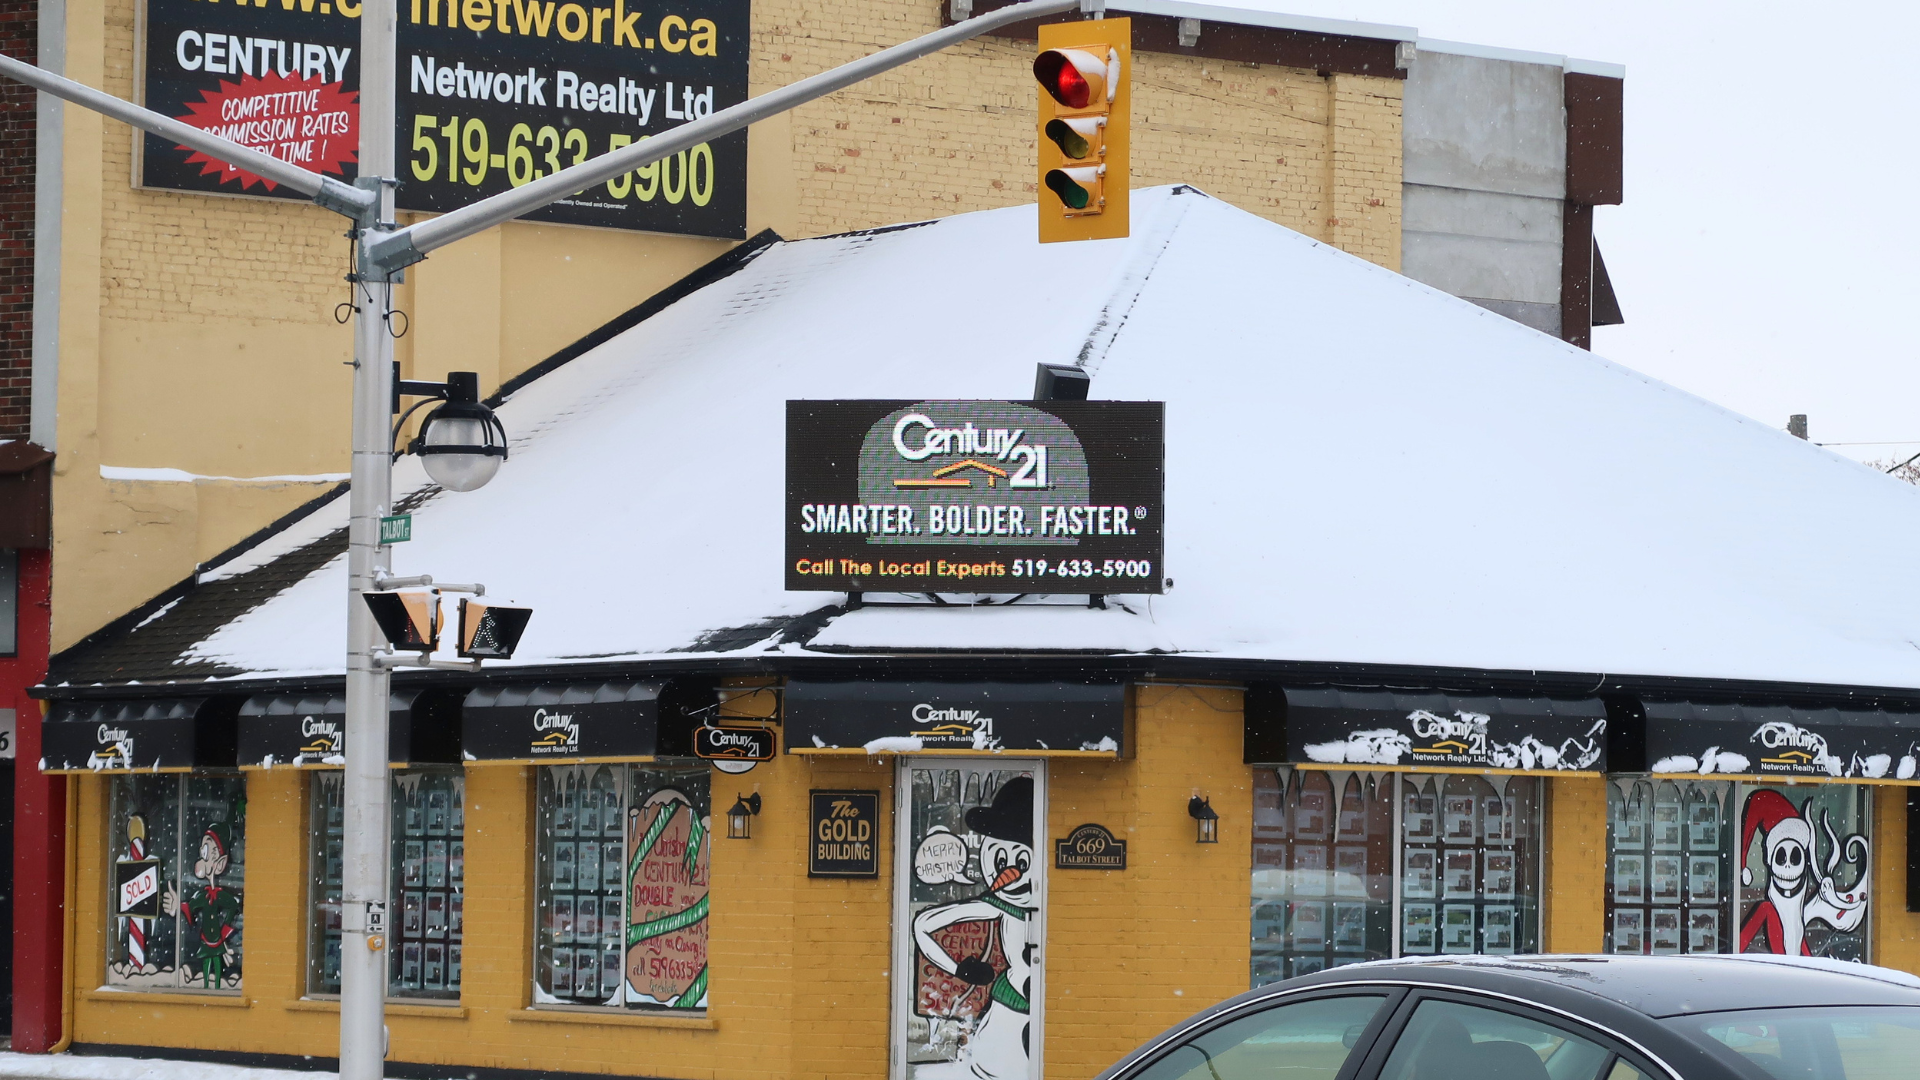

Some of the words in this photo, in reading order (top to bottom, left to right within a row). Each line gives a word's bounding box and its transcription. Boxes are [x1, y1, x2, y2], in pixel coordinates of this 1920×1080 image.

[176, 30, 351, 84] CENTURY
[410, 54, 547, 107] Network
[556, 70, 656, 126] Realty
[665, 81, 714, 121] Ltd
[221, 89, 320, 121] COMPETITIVE
[203, 116, 297, 144] OMMISSION
[301, 111, 349, 137] RATES
[280, 140, 315, 163] TIME
[411, 114, 714, 207] 519-6335900
[893, 413, 1025, 461] Century
[1009, 445, 1050, 488] 21
[382, 519, 405, 540] TALBOT
[405, 527, 410, 537] ST
[801, 504, 921, 535] SMARTER.
[930, 505, 1032, 536] BOLDER.
[796, 559, 834, 576] Call
[840, 559, 873, 576] The
[880, 560, 931, 577] Local
[937, 560, 1006, 580] Experts
[1011, 559, 1150, 578] 519-633-5900
[534, 708, 573, 731] Century
[567, 724, 579, 745] 21
[912, 703, 980, 724] Century
[973, 718, 993, 736] 21
[97, 723, 128, 745] Century
[302, 716, 336, 738] Century
[331, 731, 342, 751] 21
[709, 730, 753, 747] Century
[747, 743, 760, 757] 21
[1412, 714, 1474, 740] Ceury
[1469, 733, 1487, 755] 21
[552, 746, 568, 754] Realty
[1412, 753, 1446, 761] Network
[1447, 754, 1472, 764] Realty
[1473, 755, 1487, 763] Ltd
[1761, 763, 1791, 771] Network
[1792, 764, 1816, 774] Realty
[831, 800, 860, 818] The
[818, 818, 870, 842] GOLD
[817, 843, 871, 861] BUILDING
[922, 842, 962, 858] MERRY
[1076, 837, 1106, 854] 669
[915, 859, 964, 877] CHRISTMAS
[1062, 854, 1092, 863] TALBOT
[1092, 854, 1120, 864] STREET
[644, 859, 691, 887] CENTURY
[126, 874, 152, 906] SOLD
[635, 884, 674, 908] DOUBLE
[941, 933, 984, 952] CENTU
